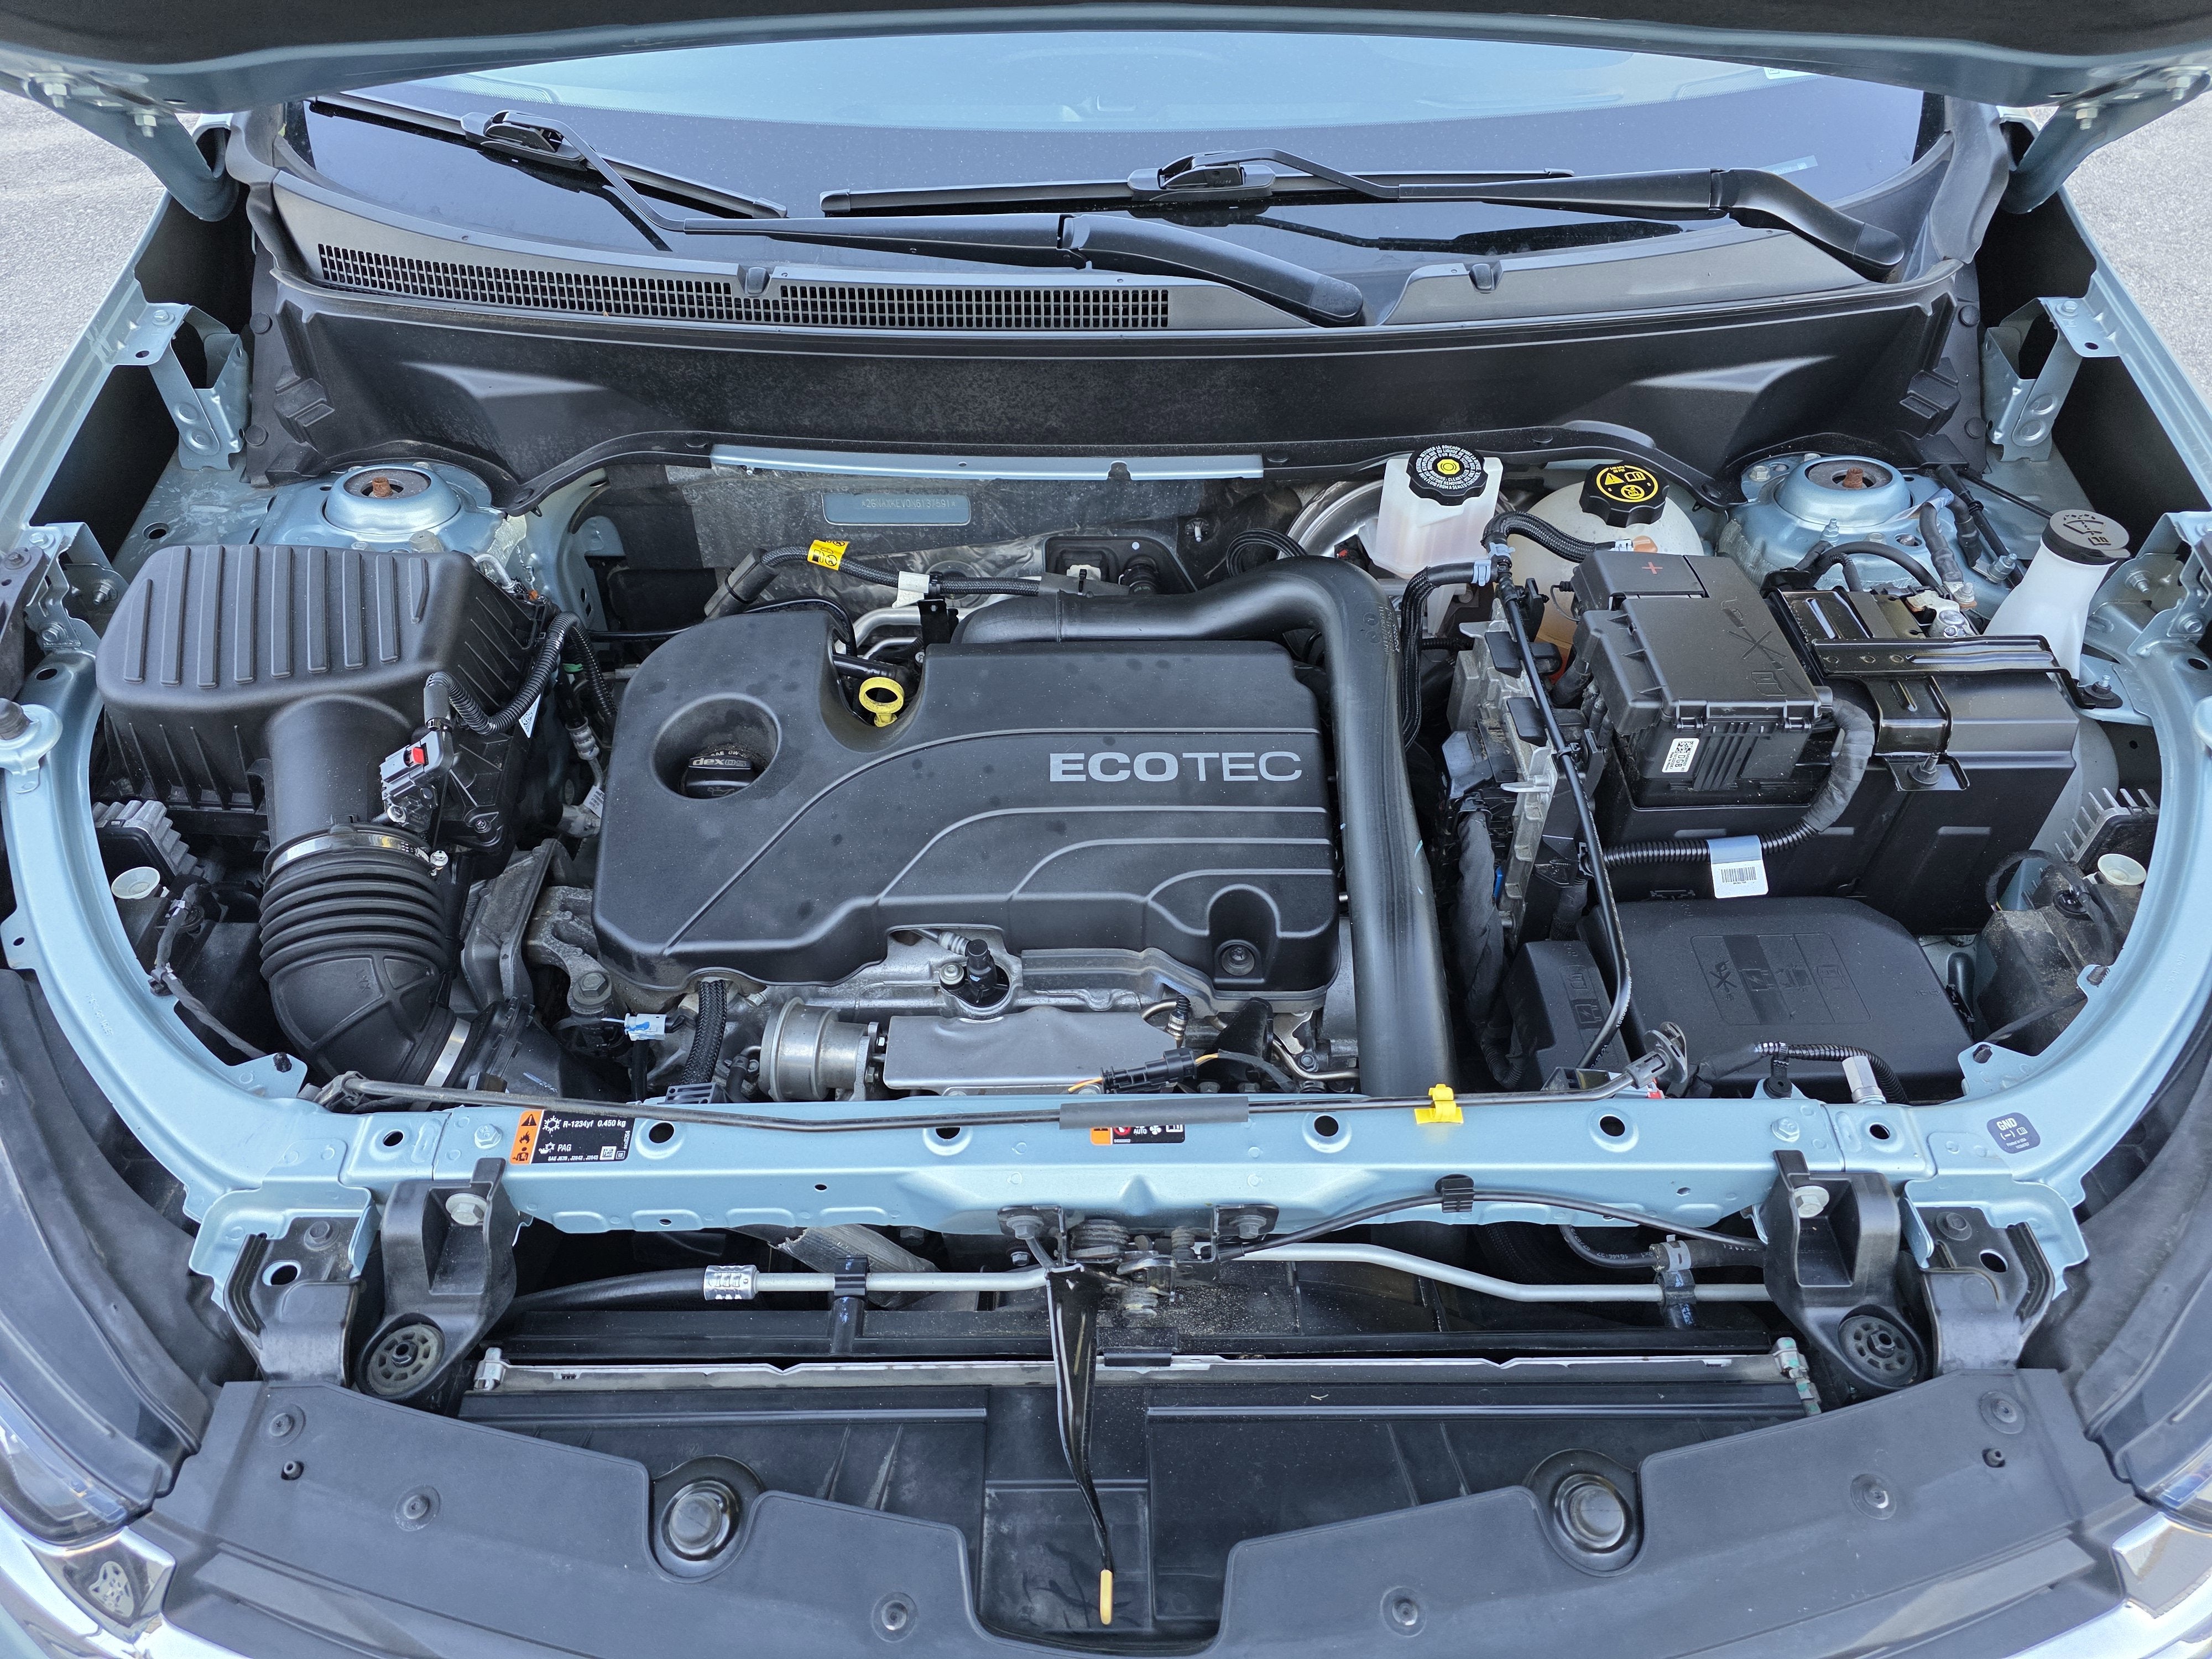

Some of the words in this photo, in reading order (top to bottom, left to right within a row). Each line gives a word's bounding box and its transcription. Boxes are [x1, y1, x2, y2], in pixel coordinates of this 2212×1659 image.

[692, 758, 747, 767] dexos
[1050, 751, 1302, 782] ECOTEC
[1675, 755, 1686, 767] DGB
[562, 1120, 594, 1128] R-1234yf
[597, 1119, 616, 1128] 0.450
[617, 1119, 627, 1128] kg
[1996, 1118, 2017, 1131] GND
[557, 1144, 572, 1152] PAG
[1569, 1224, 1590, 1251] 07/07/2
